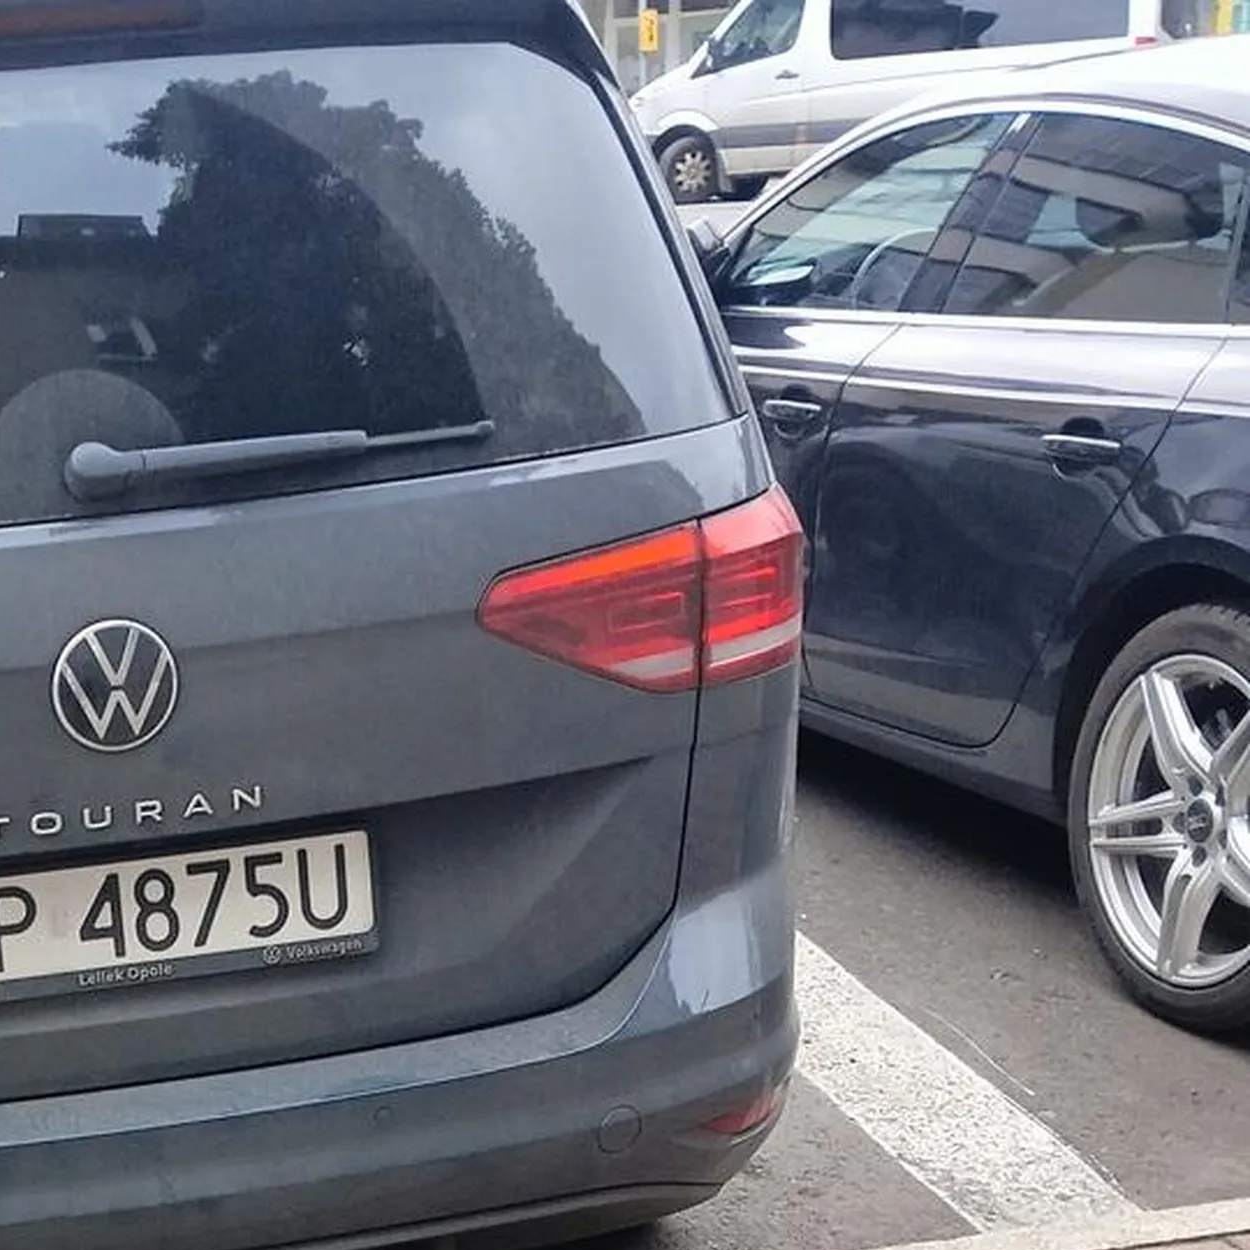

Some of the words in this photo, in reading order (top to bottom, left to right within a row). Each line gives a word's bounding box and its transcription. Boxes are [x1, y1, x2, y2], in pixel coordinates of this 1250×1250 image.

[79, 843, 350, 958] 4875U
[286, 937, 363, 960] Volkswagen
[126, 962, 174, 983] Opole
